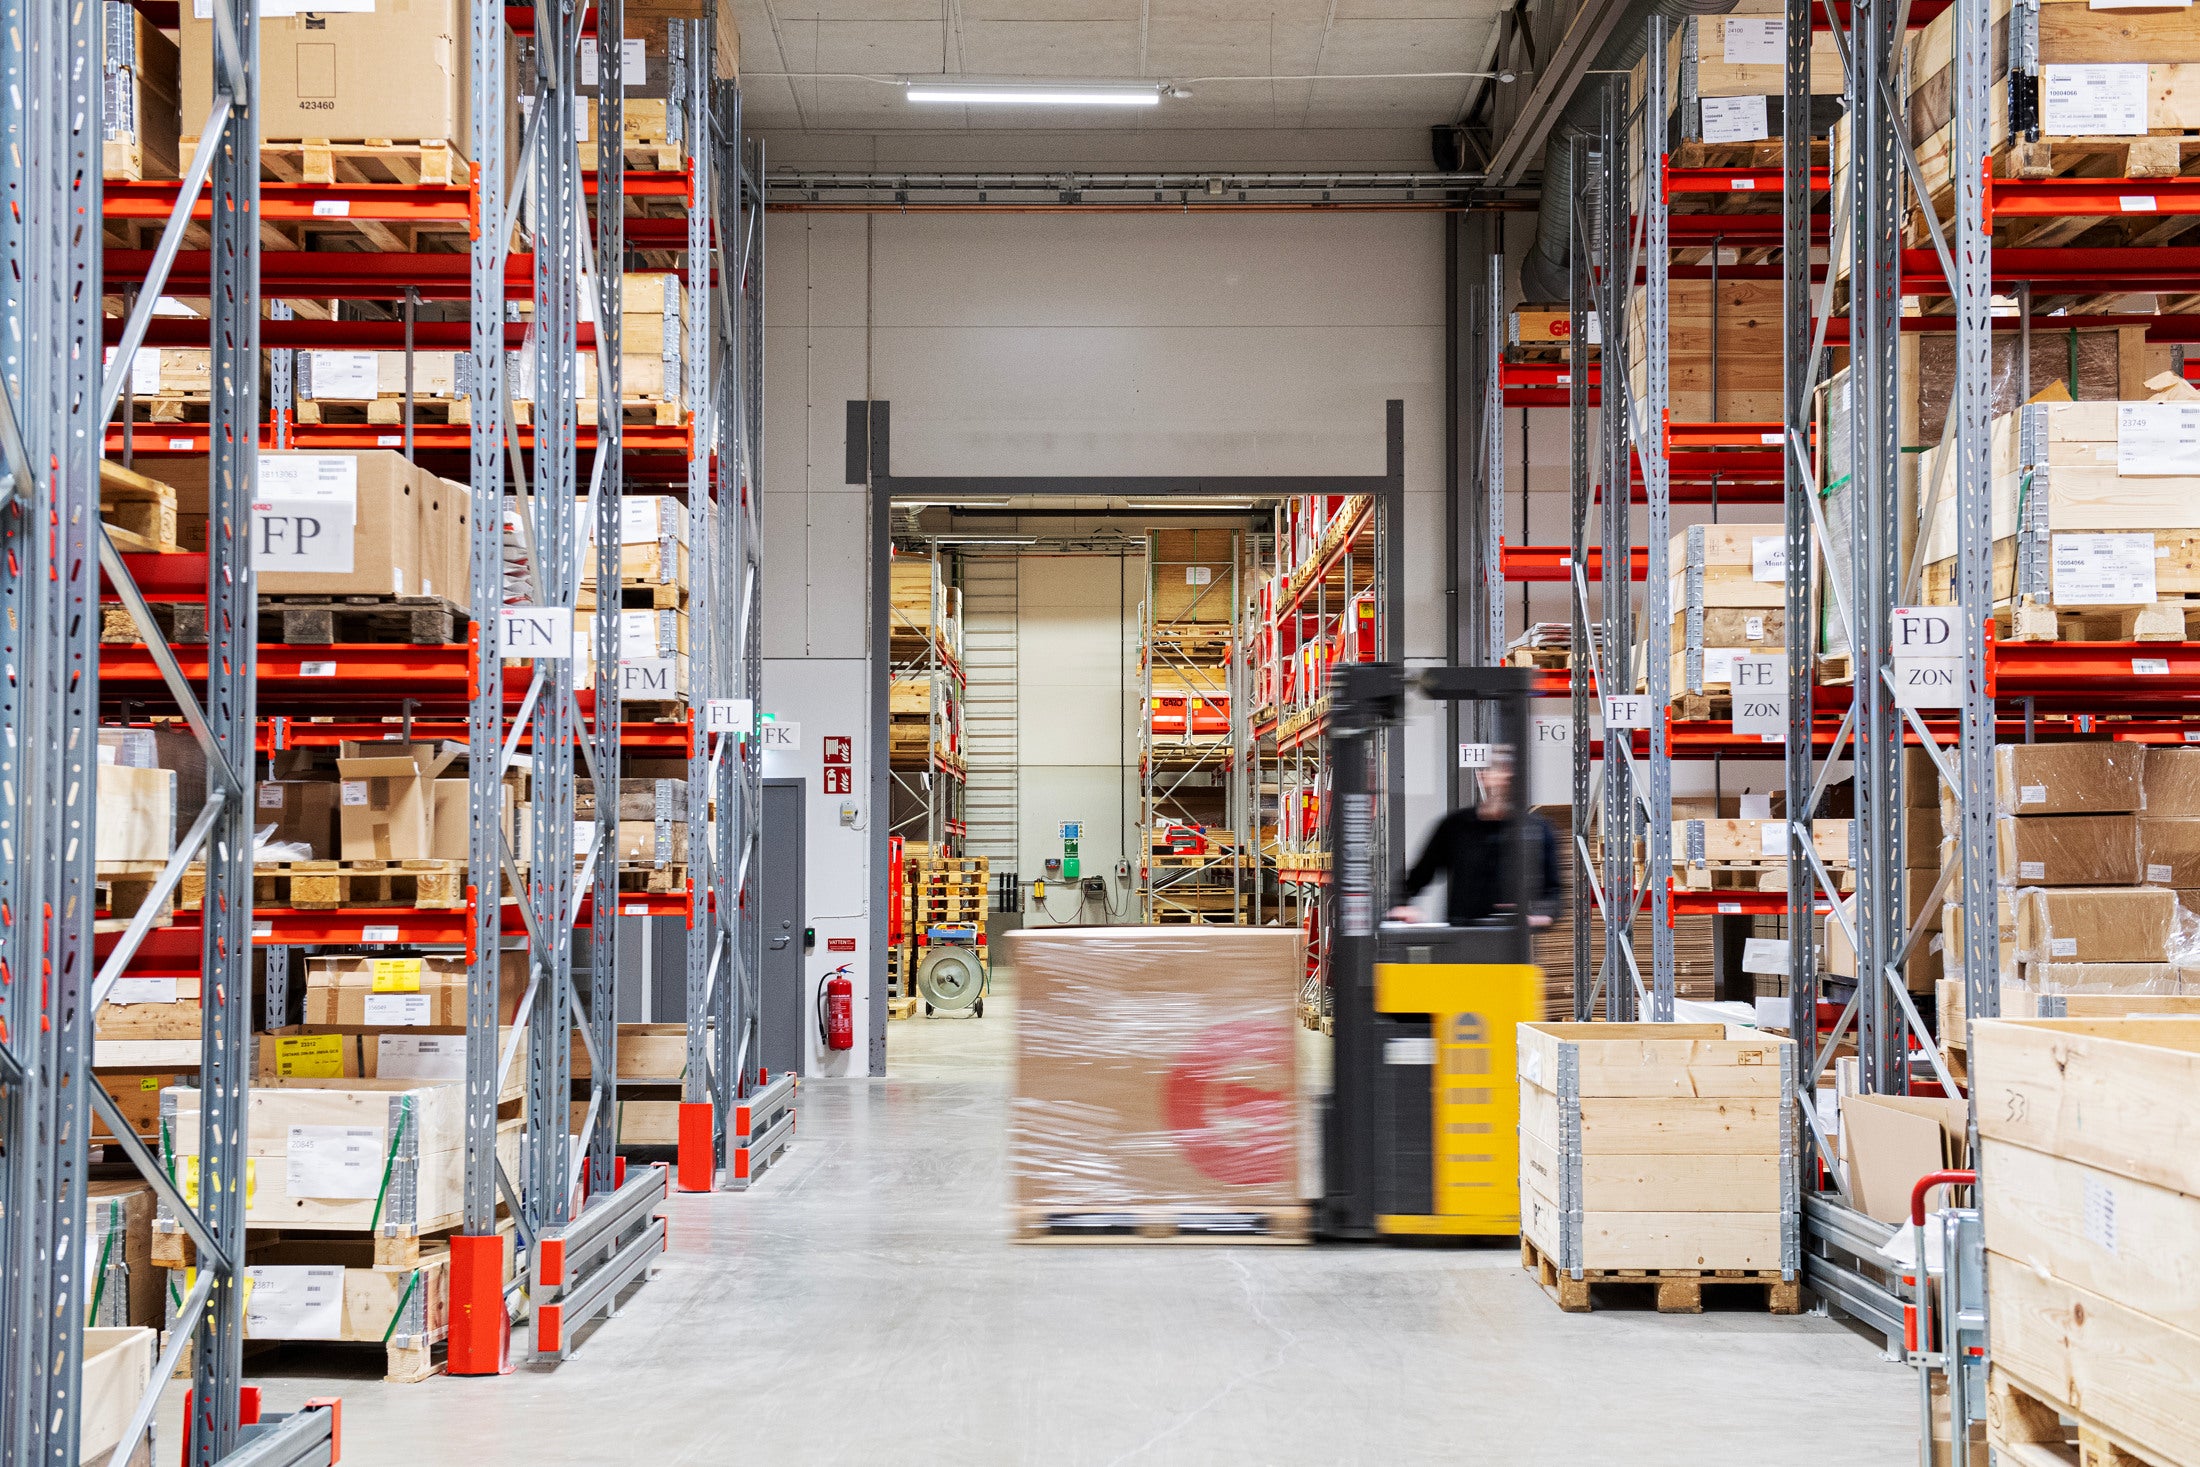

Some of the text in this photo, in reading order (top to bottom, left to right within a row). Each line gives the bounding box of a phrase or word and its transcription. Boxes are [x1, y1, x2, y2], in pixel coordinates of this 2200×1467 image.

[299, 101, 335, 110] 423460
[1549, 320, 1571, 337] GA
[2122, 419, 2147, 427] 23749
[259, 516, 322, 555] FP
[506, 618, 555, 646] FN
[1900, 617, 1950, 645] FD
[624, 667, 667, 690] FM
[1737, 663, 1774, 686] FE
[1908, 668, 1953, 686] ZON
[711, 706, 740, 725] FL
[1611, 702, 1639, 721] FF
[1743, 703, 1780, 717] ZON
[765, 727, 793, 744] FK
[1539, 724, 1566, 741] FG
[1463, 748, 1485, 762] FH
